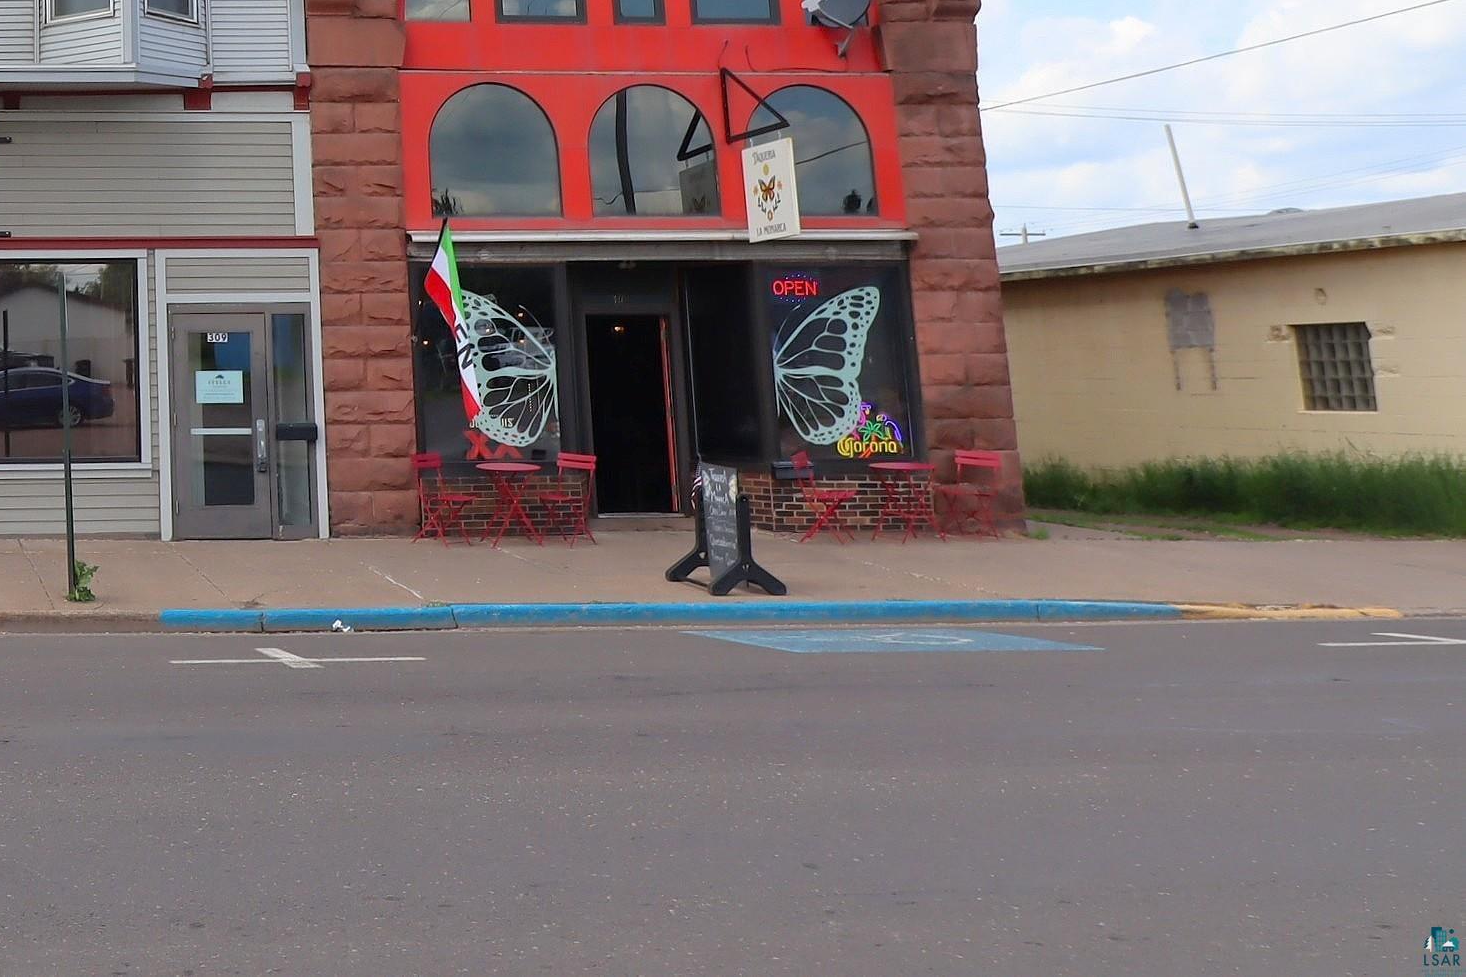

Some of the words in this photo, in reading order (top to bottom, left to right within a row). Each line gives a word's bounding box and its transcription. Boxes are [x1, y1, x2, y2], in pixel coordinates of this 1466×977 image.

[772, 280, 818, 296] OPEN
[208, 333, 227, 342] 309
[837, 436, 898, 459] Corona
